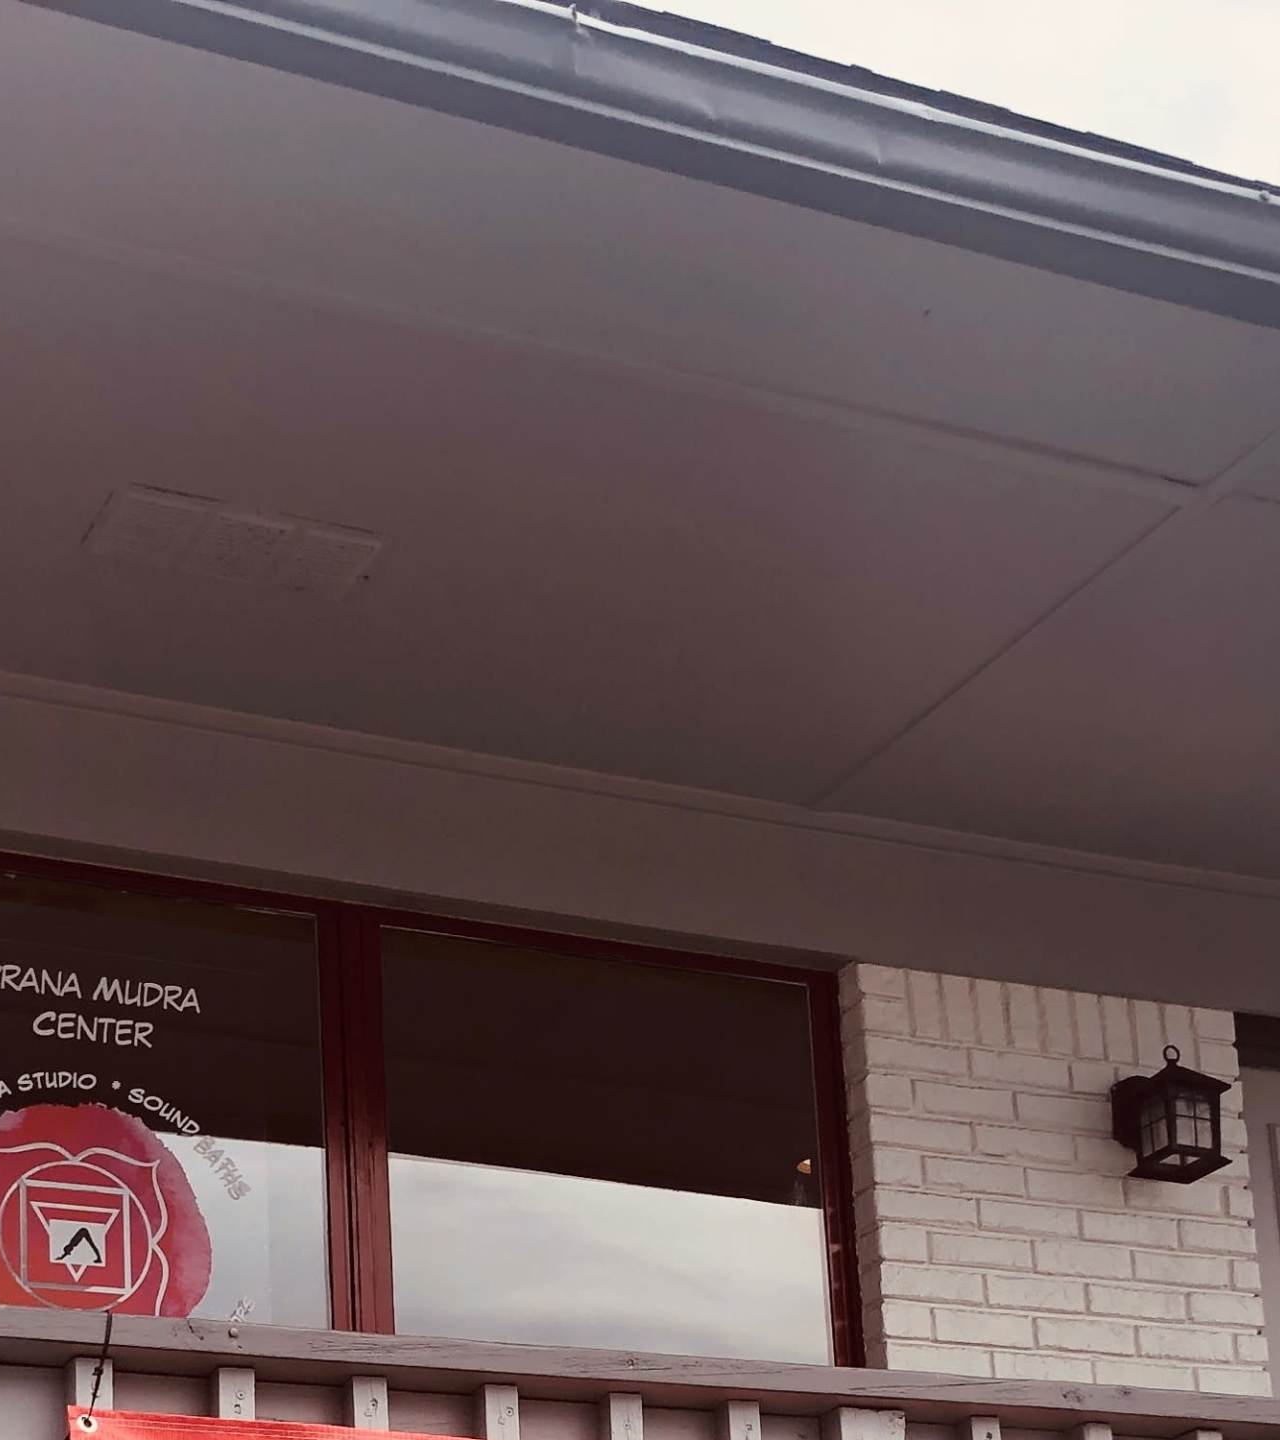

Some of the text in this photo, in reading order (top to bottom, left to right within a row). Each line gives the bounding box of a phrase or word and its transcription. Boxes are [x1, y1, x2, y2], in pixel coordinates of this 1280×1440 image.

[92, 976, 201, 1014] MUDRA
[32, 1011, 153, 1048] CENTER
[17, 1071, 97, 1091] STUDIO
[127, 1088, 201, 1136] SOUND
